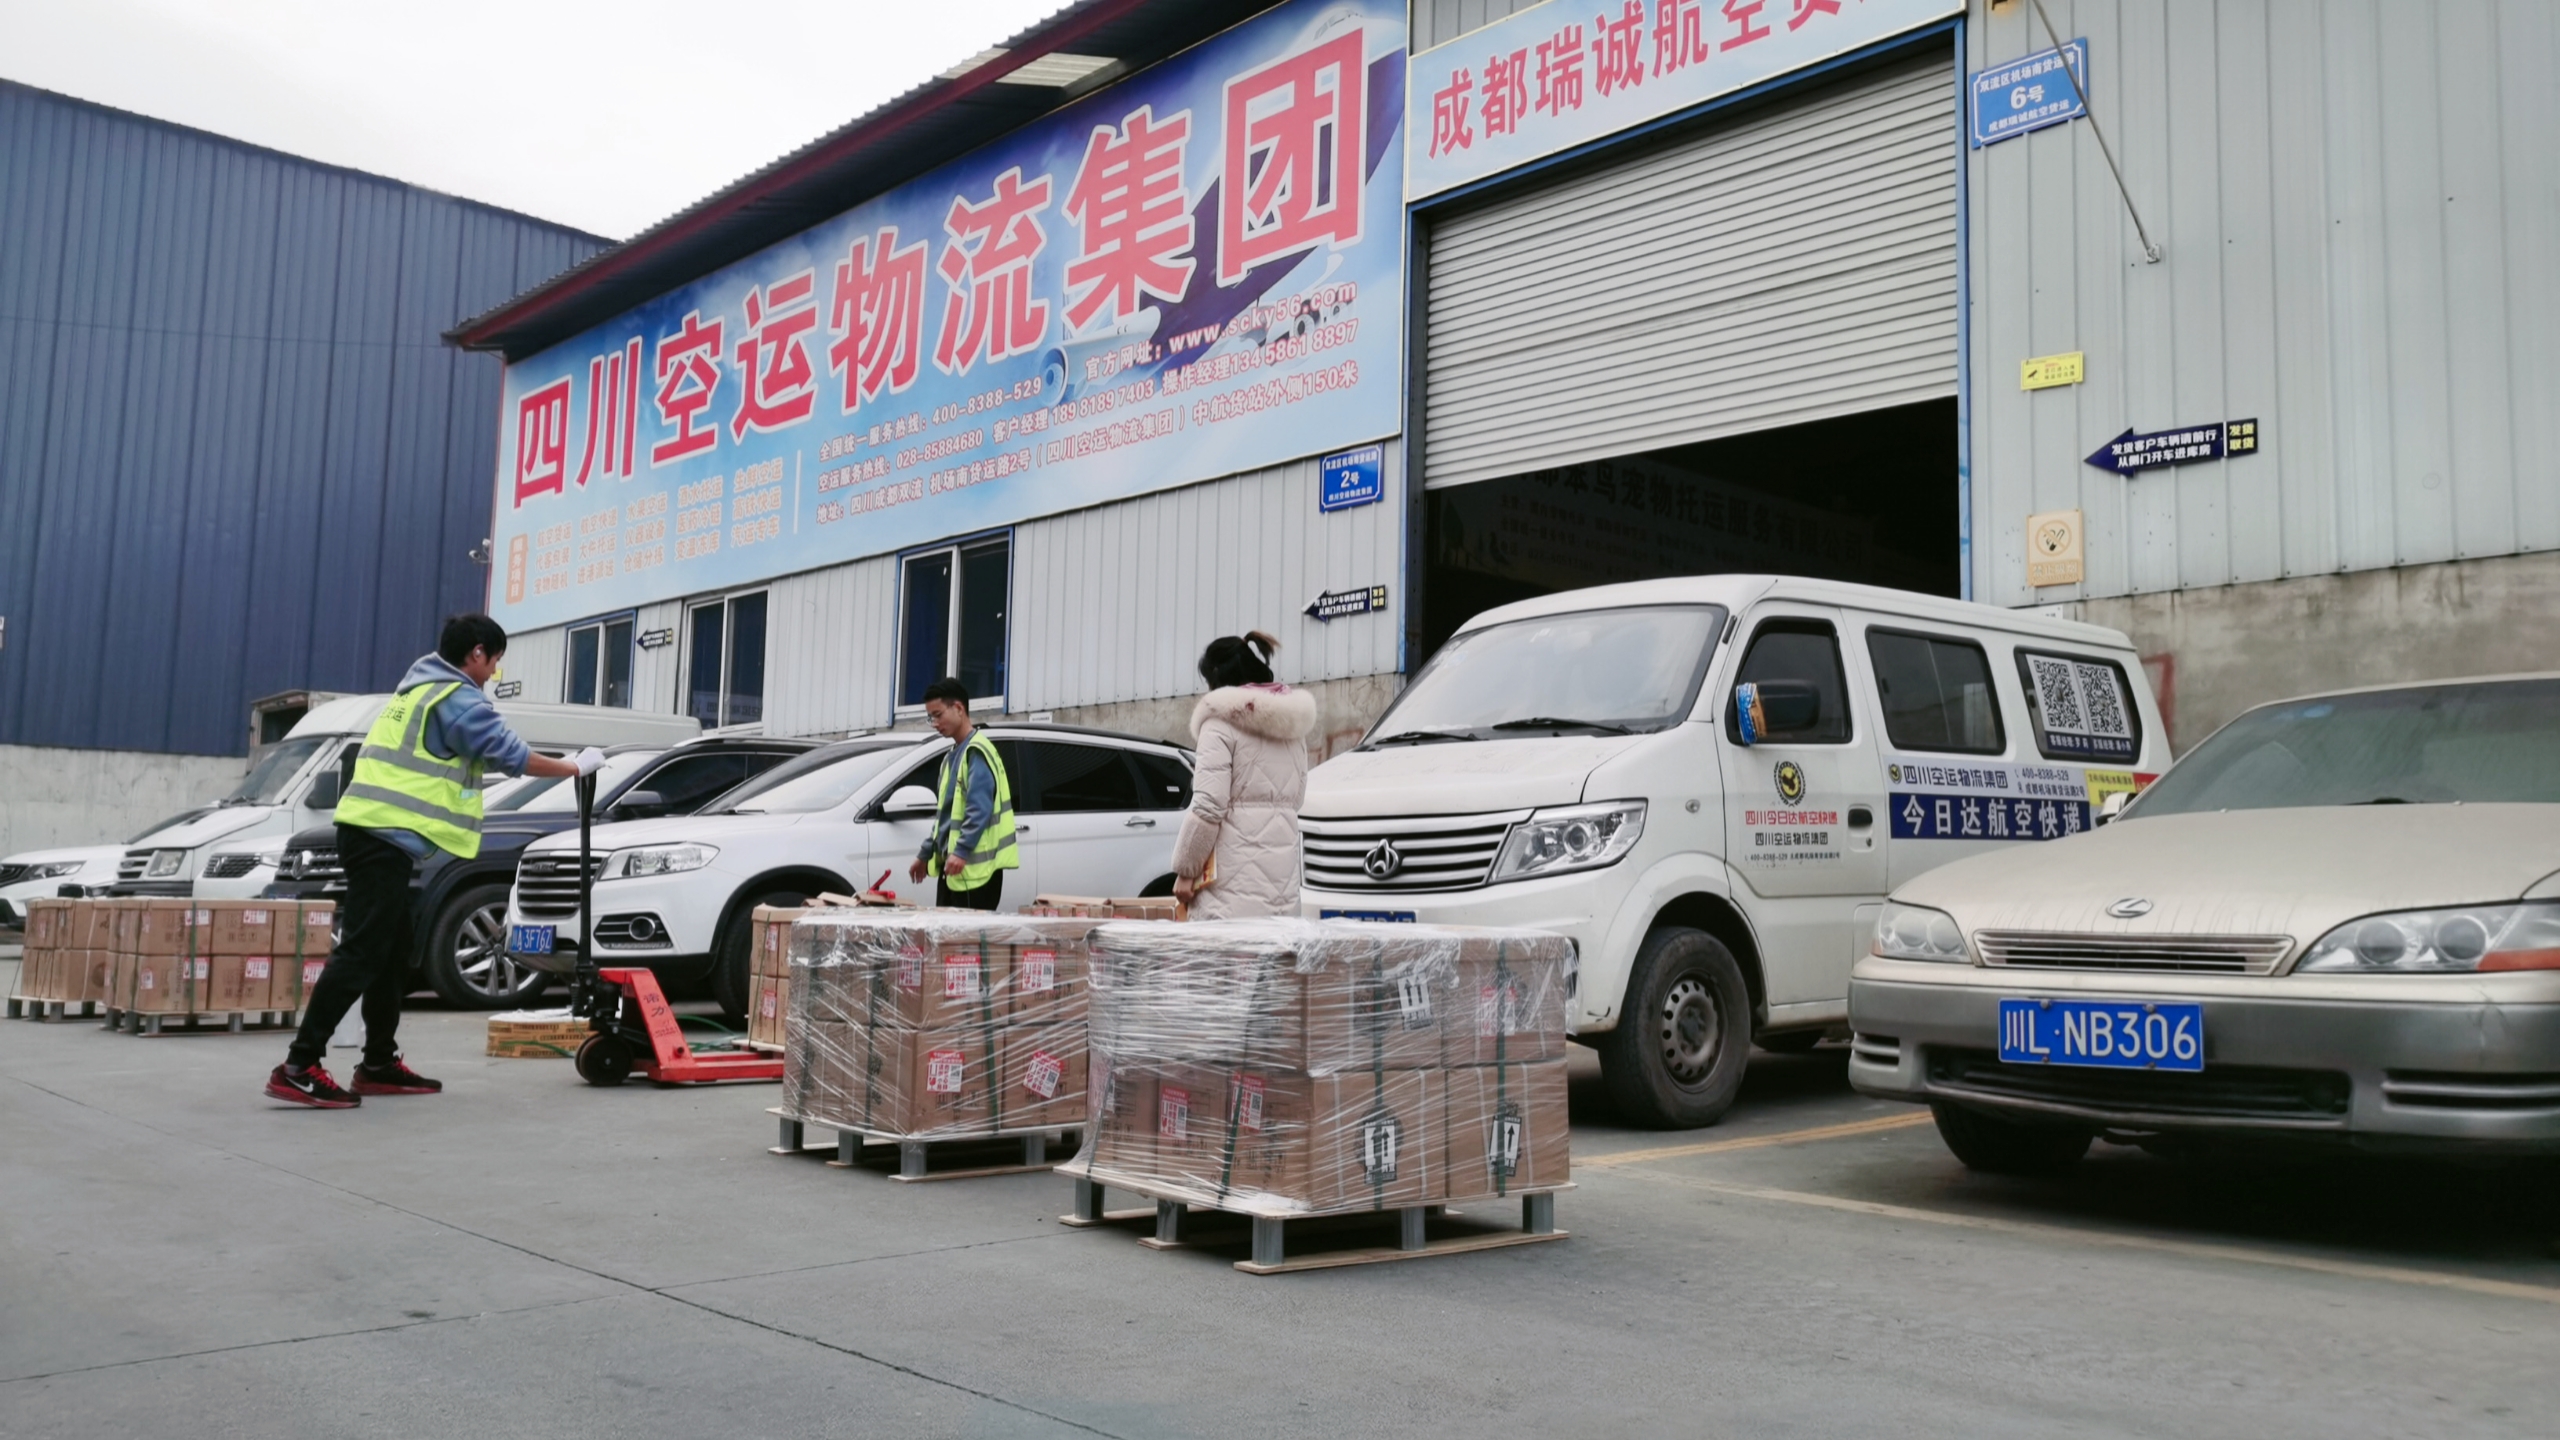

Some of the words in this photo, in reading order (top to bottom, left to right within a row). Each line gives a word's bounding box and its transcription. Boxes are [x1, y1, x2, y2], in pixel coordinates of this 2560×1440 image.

[2010, 84, 2045, 109] 6号
[513, 26, 1365, 510] 四川空运物流集团
[2111, 429, 2217, 456] 发货客户车辆请前行
[2229, 422, 2255, 436] 发货
[2117, 443, 2211, 468] 从侧门开车进库房
[2229, 437, 2255, 450] 取货
[625, 491, 668, 521] 水果空运
[677, 475, 723, 507] 酒水托运
[733, 458, 784, 493] 生鲜空运
[1340, 470, 1359, 488] 2号
[578, 533, 616, 561] 大件托运
[624, 519, 666, 548] 仪器设备
[732, 485, 782, 520] 高铁快运
[1521, 459, 1862, 567] 笨鸟宠物托运服务有限公司
[730, 515, 780, 547] 汽运专车
[509, 537, 524, 598] 服务项目
[1903, 765, 2008, 789] 四川空运物流集团
[2022, 767, 2070, 781] 400-8388-529
[1745, 810, 1838, 825] 四川今日达航空快递
[1902, 795, 2081, 838] 今日达航空快递
[1755, 832, 1828, 846] 四川空运物流集团
[2004, 1009, 2198, 1060] 川L·NB306
